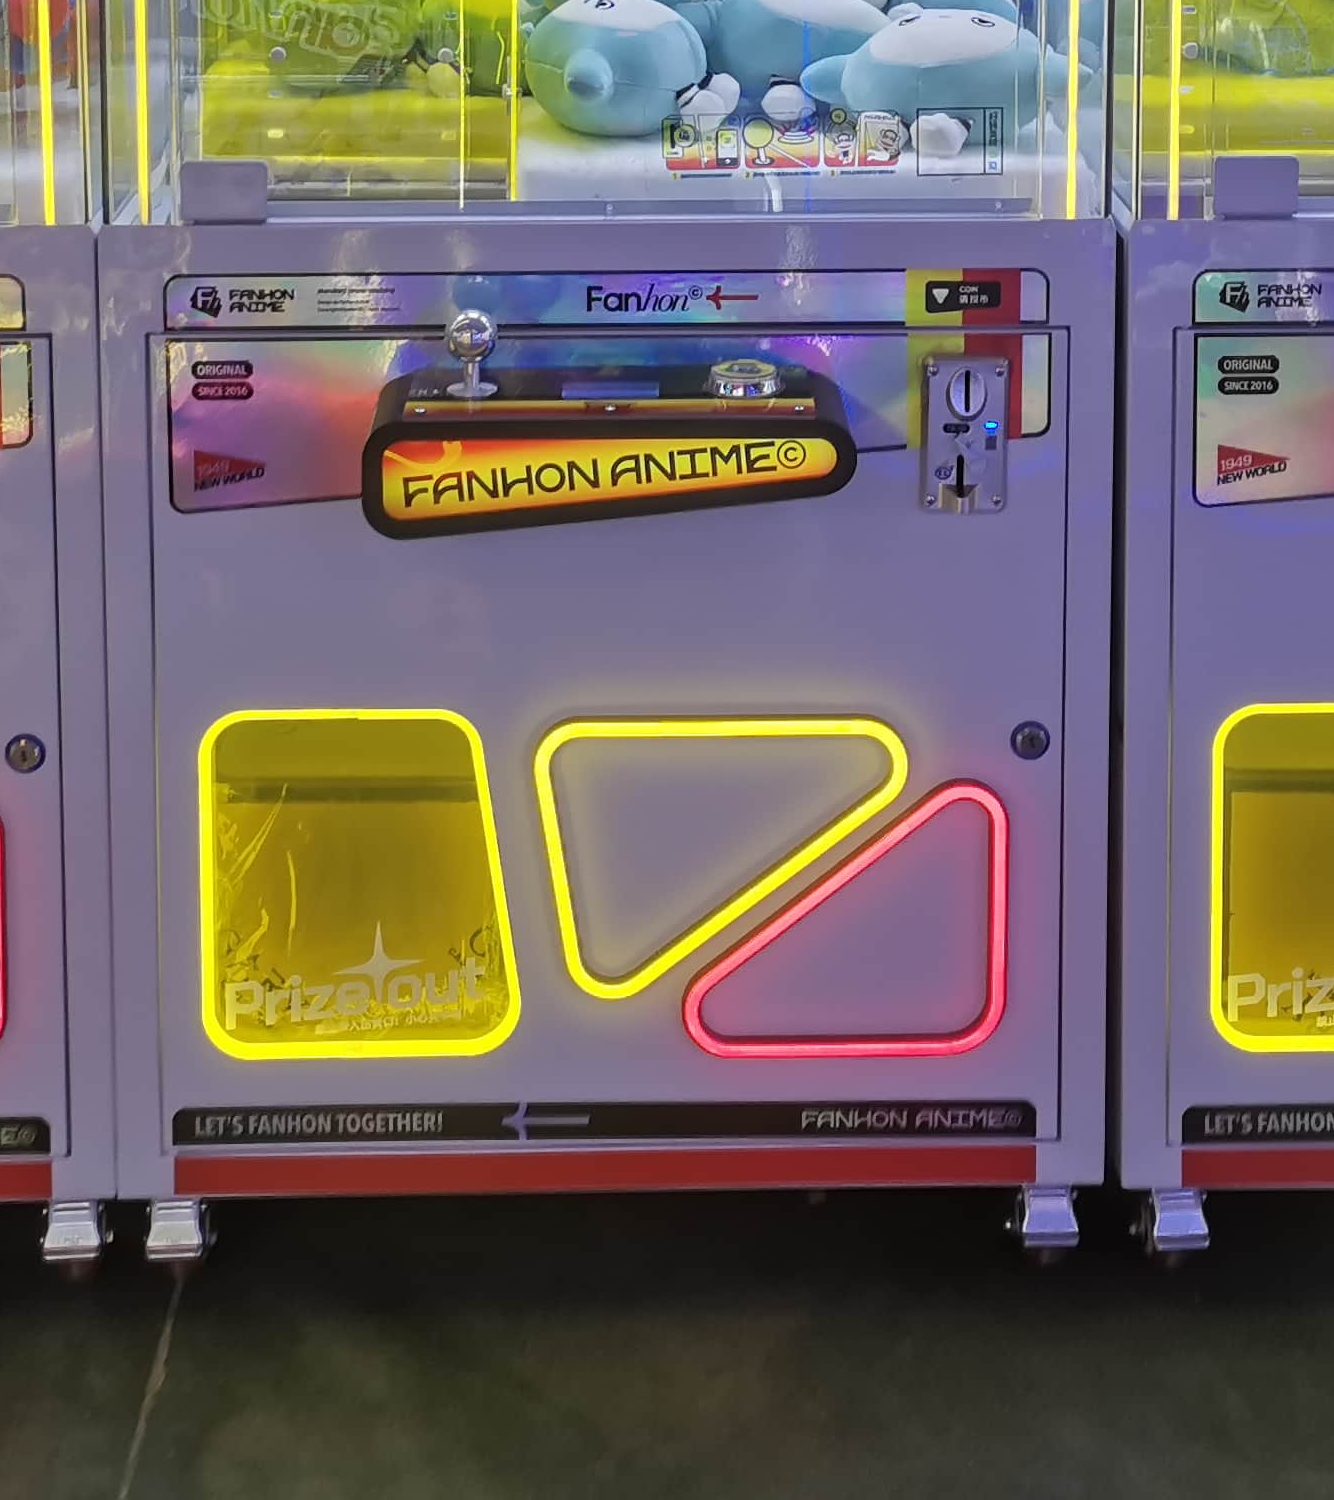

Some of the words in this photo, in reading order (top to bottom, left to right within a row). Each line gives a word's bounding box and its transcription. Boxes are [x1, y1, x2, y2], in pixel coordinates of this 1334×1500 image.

[229, 289, 295, 301] FANHON
[1258, 283, 1322, 296] FANHON
[197, 363, 247, 376] ORIGINAL
[1223, 357, 1274, 371] ORIGINAL
[1224, 379, 1249, 392] SINCE
[1250, 379, 1274, 392] 2016
[1220, 454, 1253, 470] 1949
[1217, 469, 1244, 485] NEW
[1246, 460, 1287, 481] WORLD
[403, 458, 600, 508] FANHON
[225, 974, 370, 1031] Prize
[195, 1115, 244, 1137] LET'S
[249, 1113, 333, 1136] FANHON
[336, 1112, 444, 1135] TOGETHER!
[801, 1107, 908, 1130] FANHON
[1204, 1112, 1252, 1136] LET'S
